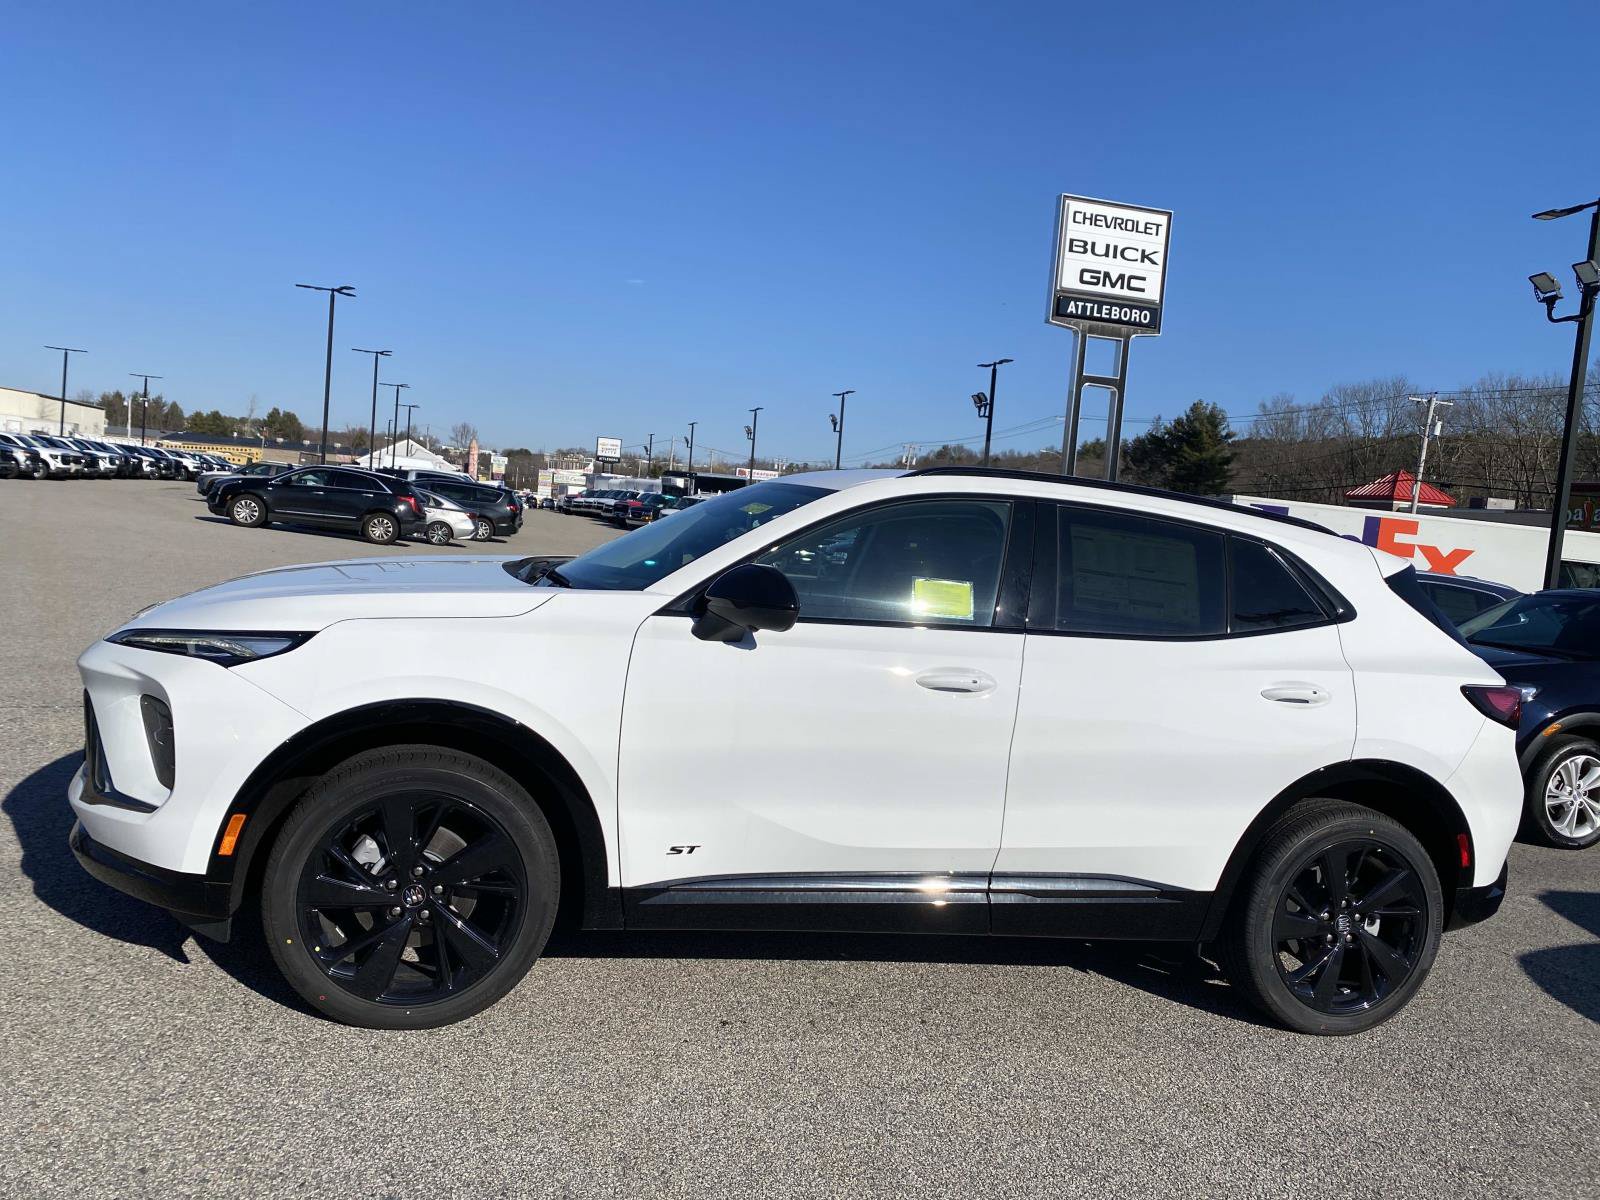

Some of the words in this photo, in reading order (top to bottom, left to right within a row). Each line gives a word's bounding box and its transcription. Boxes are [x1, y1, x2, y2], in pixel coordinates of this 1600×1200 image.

[1072, 210, 1163, 236] CHEVROLET
[1068, 237, 1160, 266] BUICK
[1079, 267, 1147, 293] GMC
[1067, 300, 1151, 324] ATTLEBORO
[666, 845, 702, 855] ST
